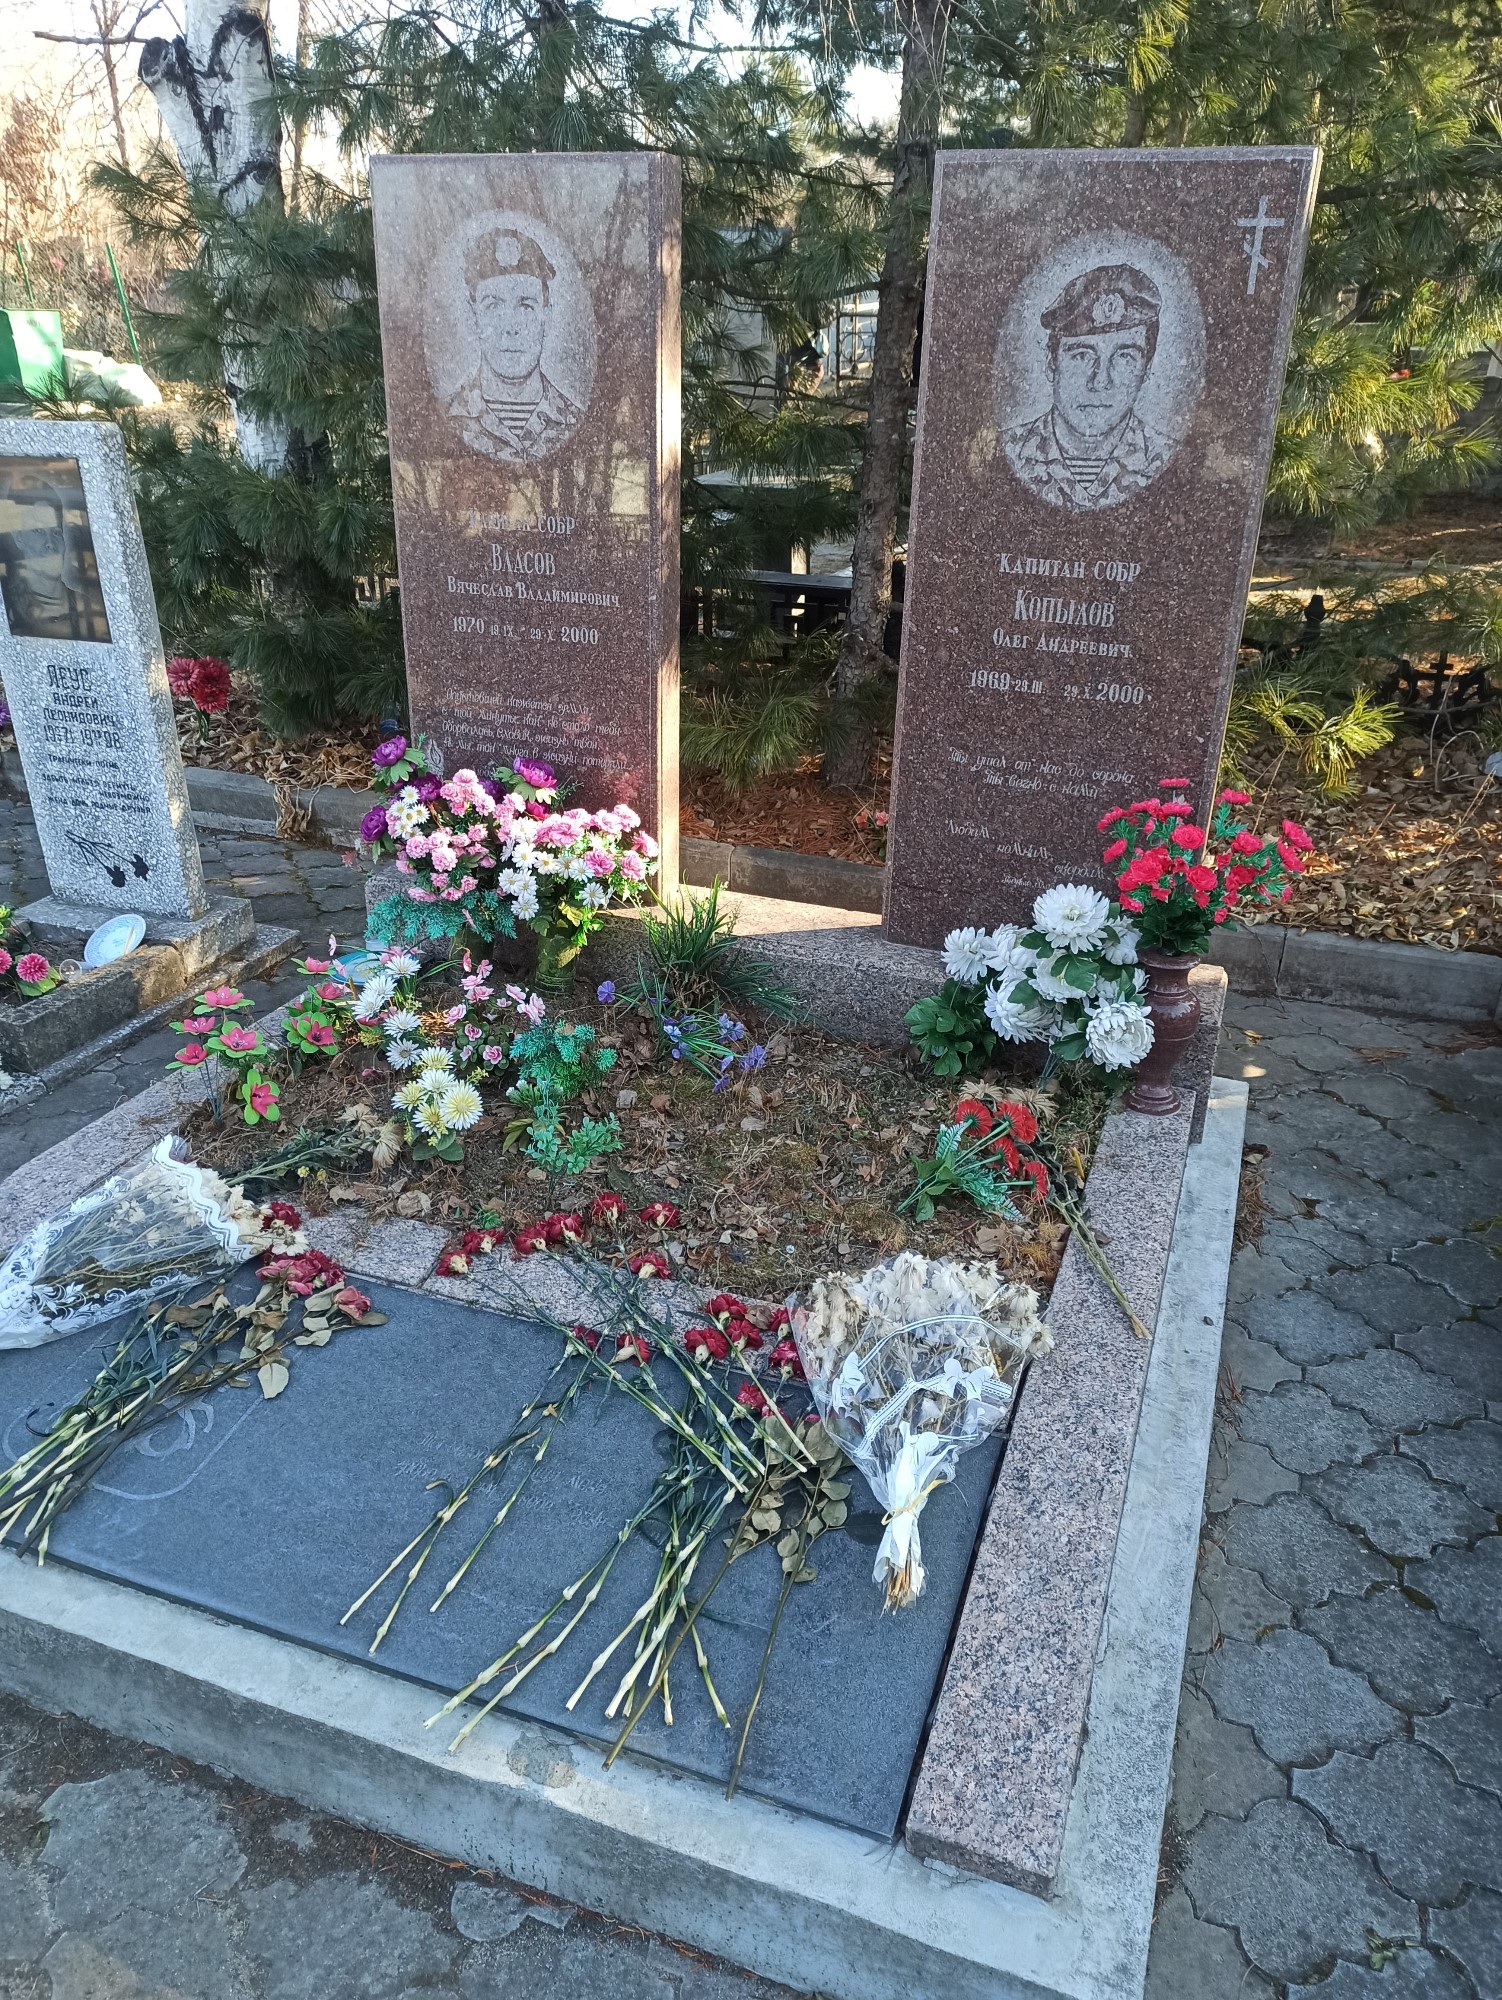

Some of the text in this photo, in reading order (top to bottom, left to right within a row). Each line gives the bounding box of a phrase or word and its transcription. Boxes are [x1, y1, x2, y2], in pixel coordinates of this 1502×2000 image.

[537, 515, 576, 534] СОБР
[491, 543, 556, 576] ВЛАСОВ
[999, 553, 1141, 582] КАПИТАН СОБР
[447, 575, 621, 608] ВЯЧЕСЛАВ ВЛАДИМИРОВИЧ
[1014, 589, 1116, 628] КОПЫЛОВ
[452, 616, 485, 634] 1970
[561, 626, 599, 645] 2000
[993, 627, 1030, 649] ОЛЕГ
[47, 665, 92, 692] ЛЕУС
[970, 669, 1011, 690] 1969
[1098, 682, 1145, 705] 2000
[43, 707, 115, 727] ЛЕОНИДОВИЧ
